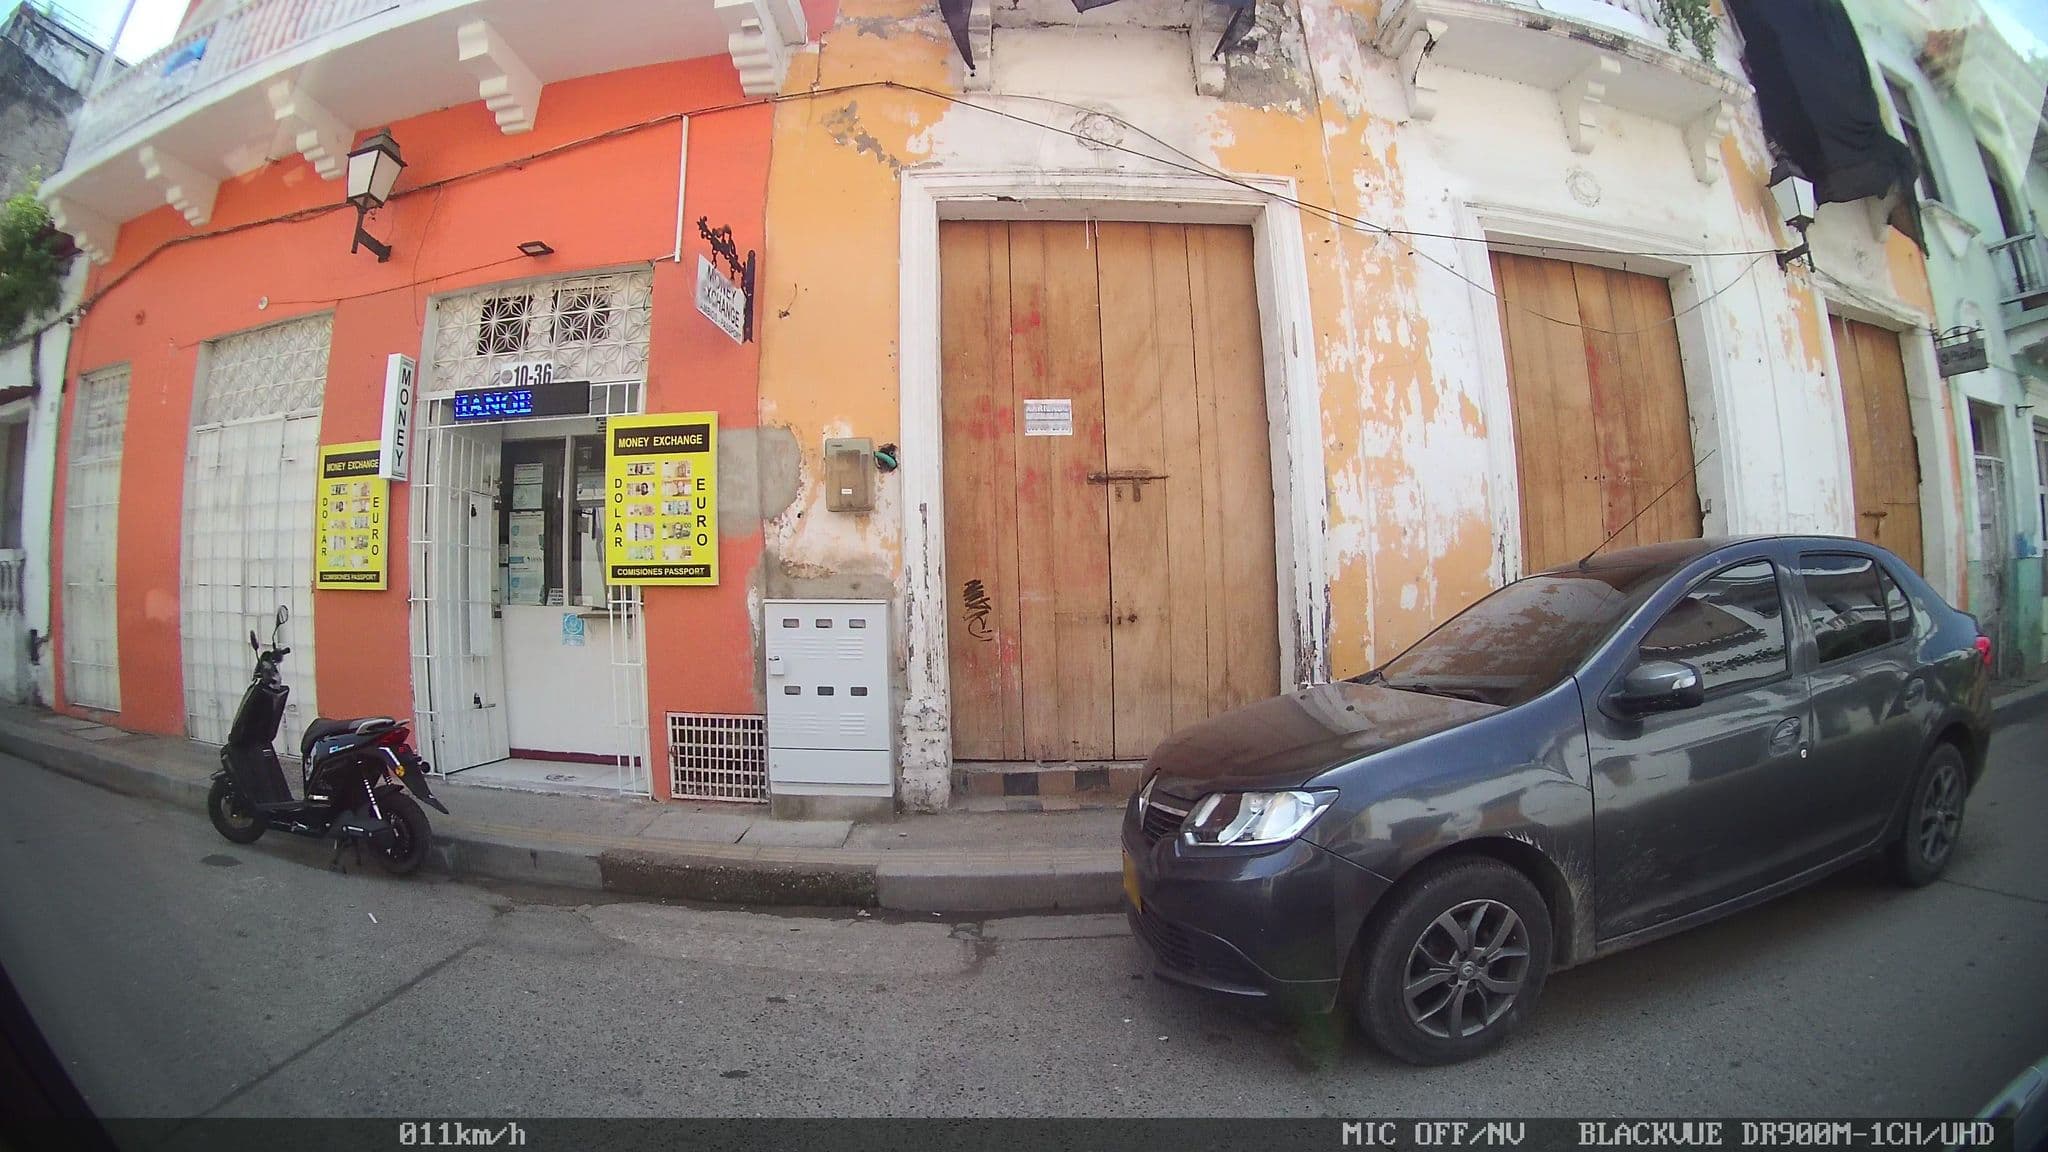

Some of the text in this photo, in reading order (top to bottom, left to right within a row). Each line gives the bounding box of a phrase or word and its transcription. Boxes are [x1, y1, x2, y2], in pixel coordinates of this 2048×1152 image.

[700, 282, 740, 329] XCHANGE
[514, 363, 552, 386] 10-36
[395, 368, 411, 467] MONEY
[618, 434, 703, 448] MONEY EXCHANGE
[326, 458, 379, 472] MONEY EXCHANGE
[371, 497, 380, 556] EURO
[615, 478, 623, 547] DOLAR
[696, 478, 708, 546] EURO
[617, 567, 705, 576] COMISIONES PASSPORT
